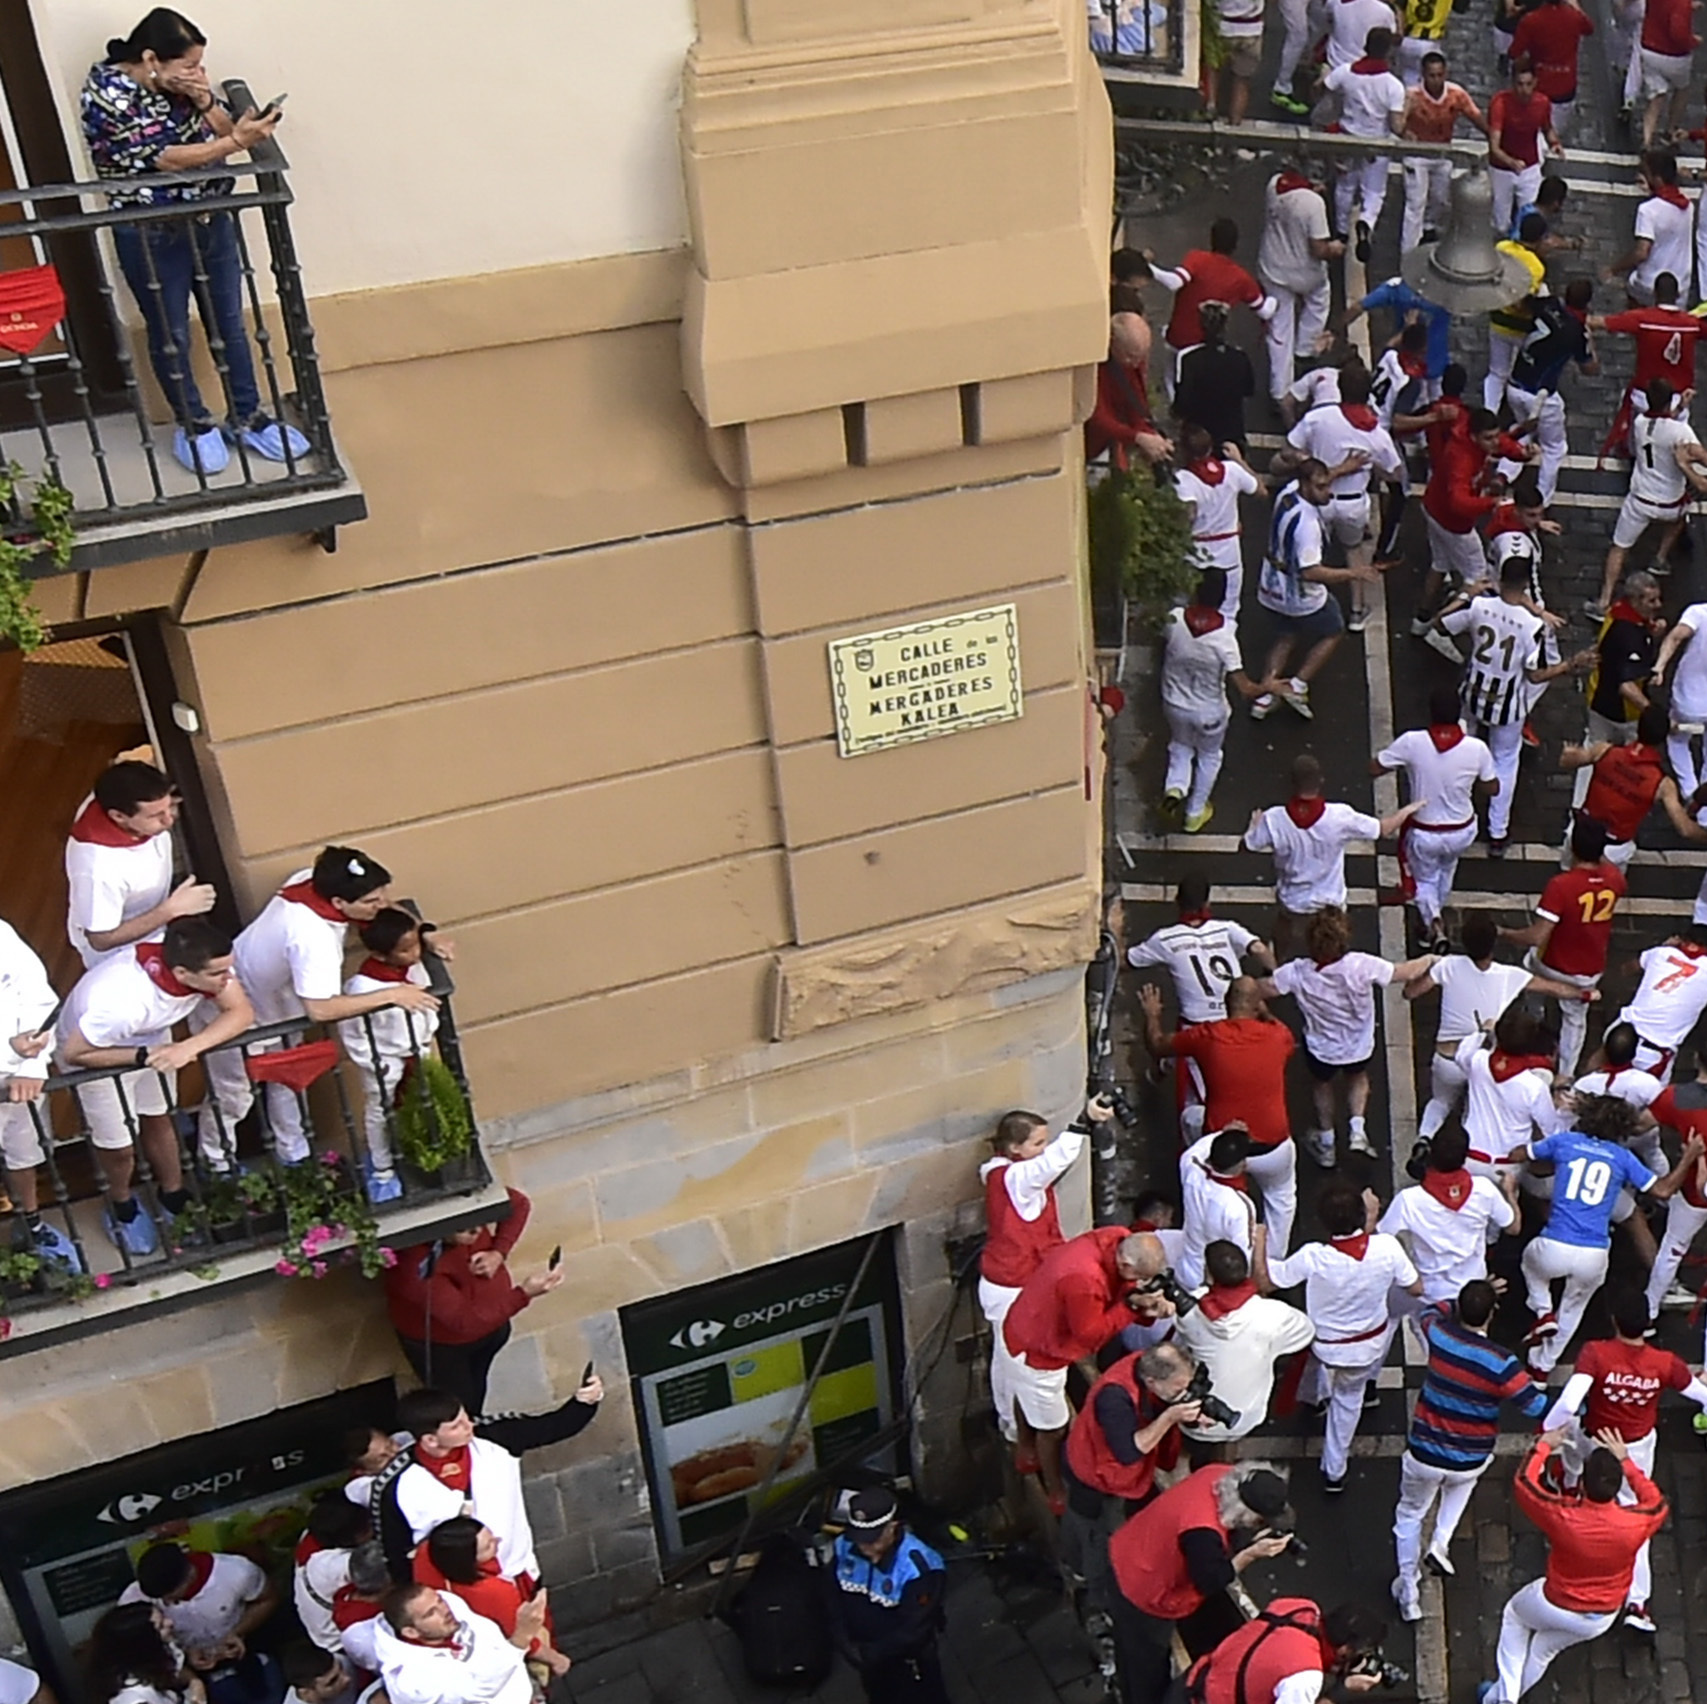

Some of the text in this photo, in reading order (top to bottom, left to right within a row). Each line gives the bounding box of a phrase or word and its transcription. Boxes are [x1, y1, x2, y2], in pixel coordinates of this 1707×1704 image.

[1662, 331, 1682, 365] 4
[1642, 442, 1655, 469] 1
[901, 638, 954, 662] CALLE
[1474, 624, 1517, 673] 21
[869, 652, 988, 690] MERCADERES
[869, 676, 993, 716] MERCADERES
[901, 702, 960, 727] KALEA
[1578, 889, 1616, 924] 12
[1653, 955, 1700, 994] 7
[1565, 1157, 1612, 1206] 19
[733, 1283, 847, 1329] express
[1604, 1371, 1661, 1390] ALGABA
